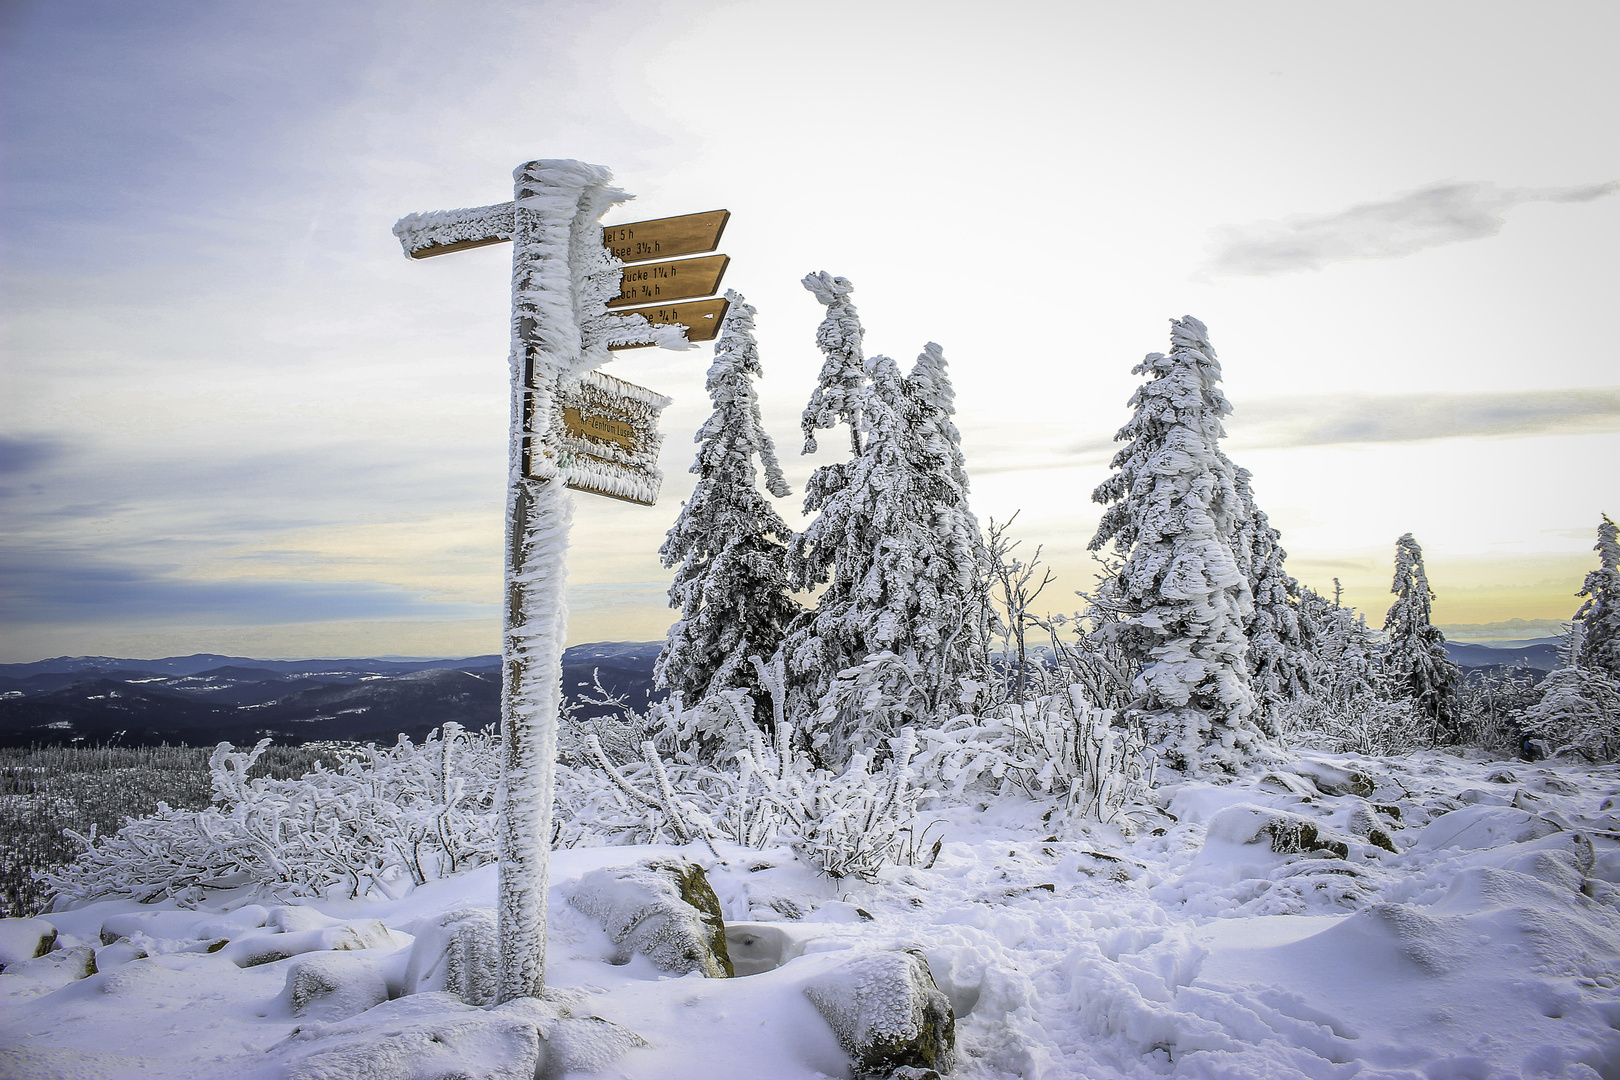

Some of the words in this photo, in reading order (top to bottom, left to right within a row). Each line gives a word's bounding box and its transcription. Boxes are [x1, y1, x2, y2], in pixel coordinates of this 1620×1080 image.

[604, 231, 616, 243] el
[619, 229, 626, 241] 5
[628, 228, 634, 240] h
[611, 246, 632, 258] lsee
[655, 240, 660, 252] h
[621, 269, 649, 284] rücke
[671, 265, 677, 277] h
[618, 286, 637, 300] och
[655, 284, 660, 296] h
[672, 308, 678, 320] h
